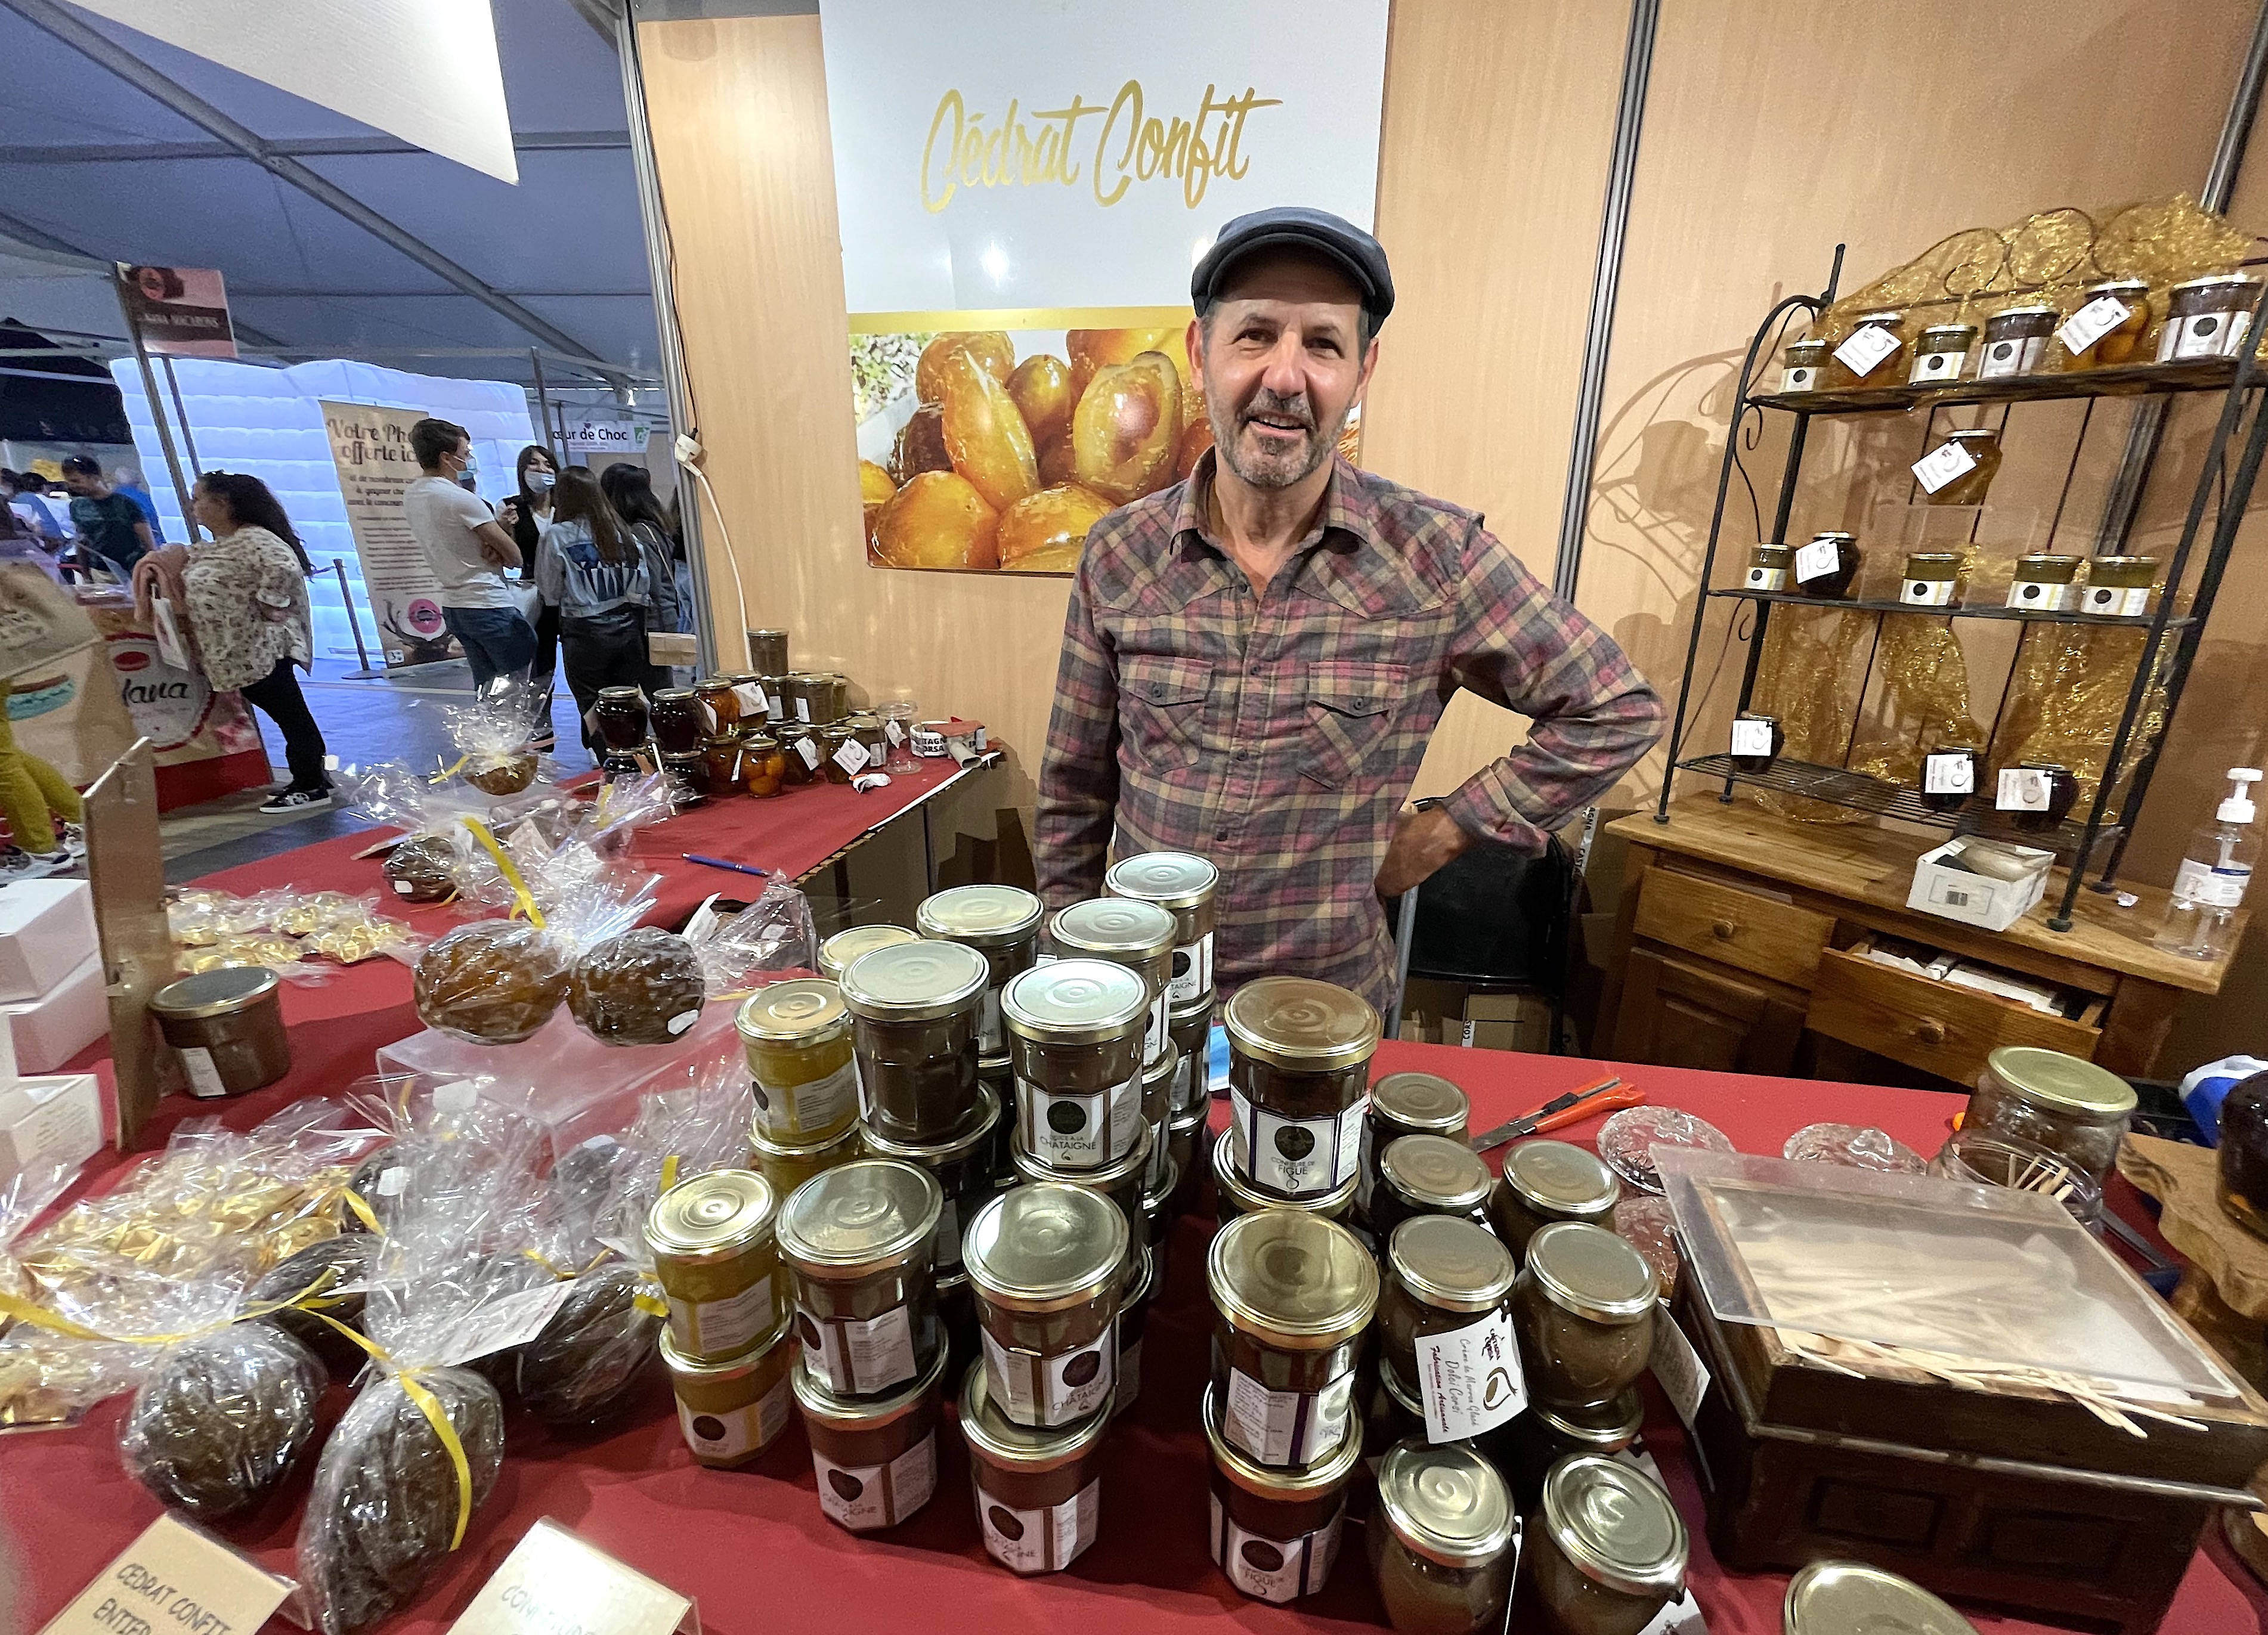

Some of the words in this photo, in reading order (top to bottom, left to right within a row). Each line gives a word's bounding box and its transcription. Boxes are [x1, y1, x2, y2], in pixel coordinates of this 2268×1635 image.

[921, 88, 1109, 213] Cédrat
[1093, 79, 1283, 209] Confit
[327, 419, 379, 441] Votre
[580, 428, 595, 440] de
[598, 429, 627, 441] Choc
[341, 441, 398, 465] offerte
[401, 445, 418, 462] ic
[1170, 980, 1197, 990] TAIGNE
[1463, 1019, 1472, 1040] CORS
[1039, 1137, 1097, 1150] CHATAIGNE
[1278, 1165, 1308, 1179] FIGUE
[1445, 1360, 1462, 1386] Dolci
[1430, 1345, 1441, 1389] Fabrication
[1437, 1392, 1450, 1433] Artisanale
[117, 1563, 178, 1605] CEDRAT
